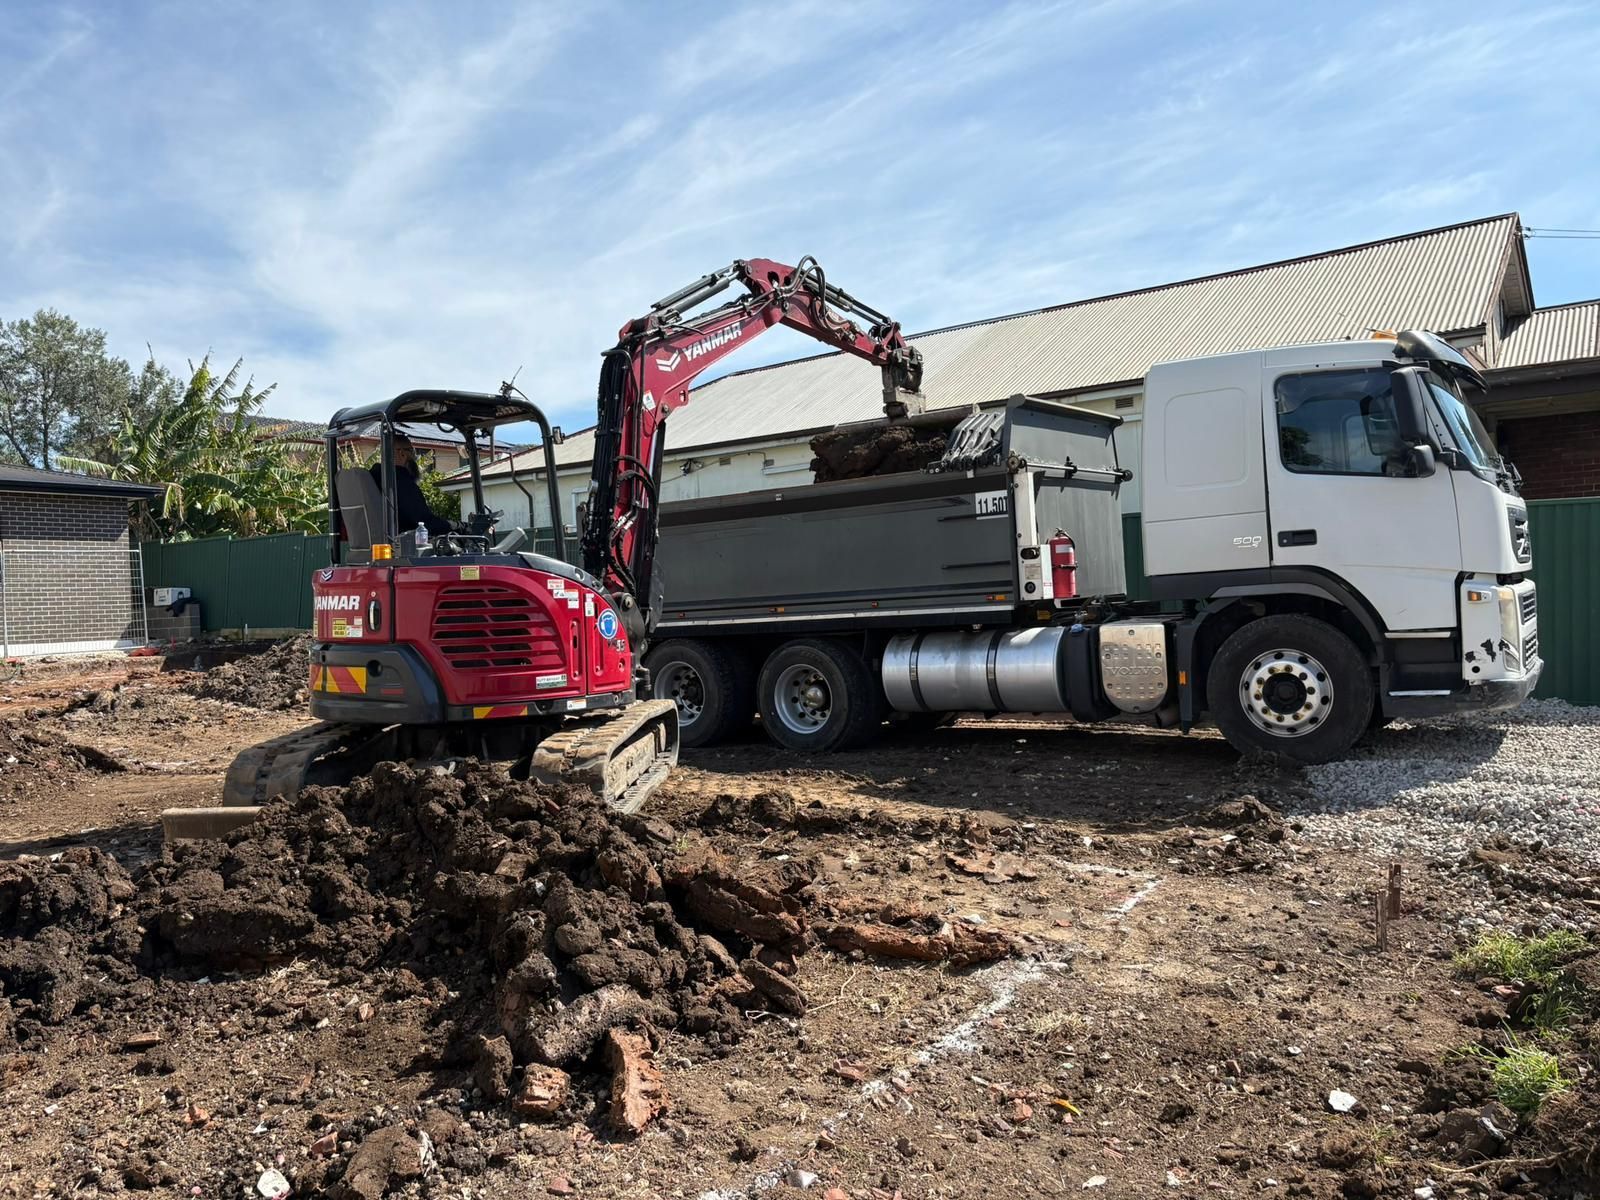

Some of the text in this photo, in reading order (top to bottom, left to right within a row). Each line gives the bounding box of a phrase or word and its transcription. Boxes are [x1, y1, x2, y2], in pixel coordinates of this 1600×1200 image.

[681, 322, 743, 362] YANMAR
[1232, 535, 1262, 545] 500
[1105, 665, 1163, 676] VOLVO
